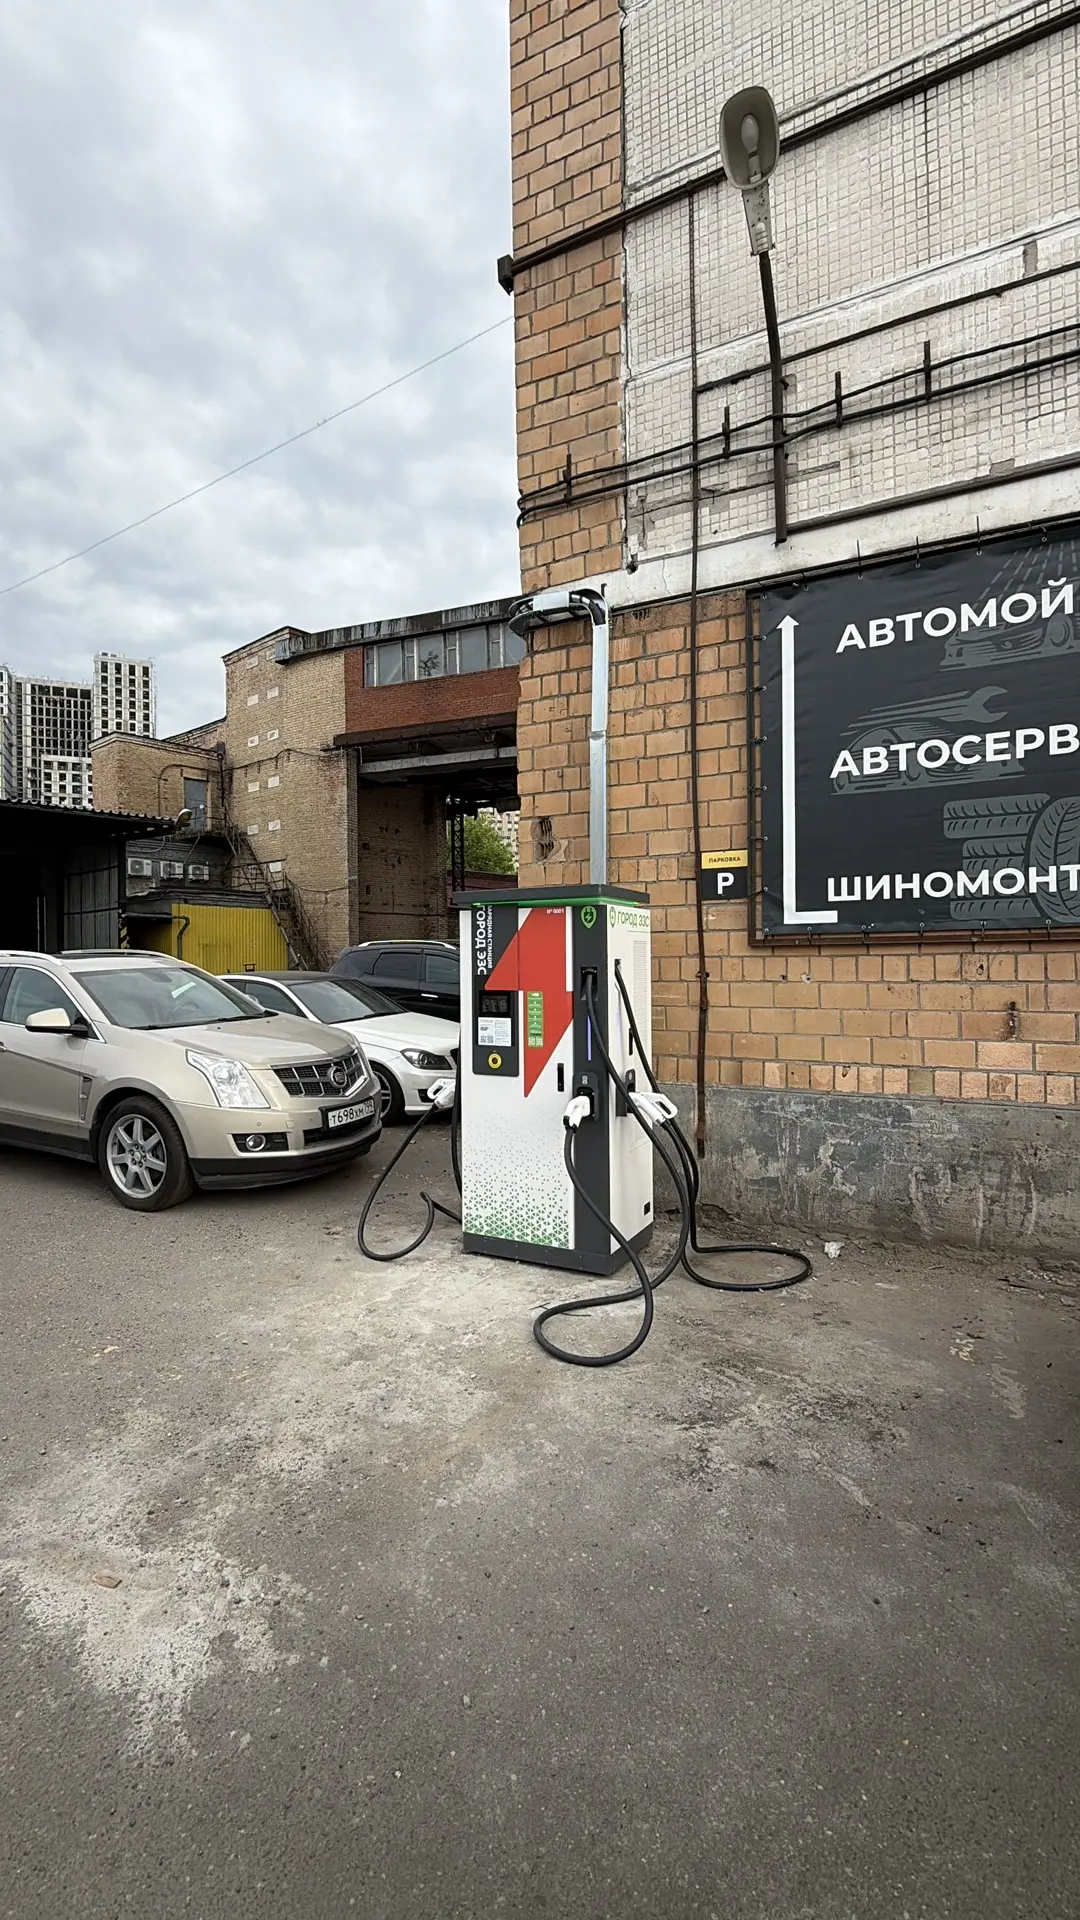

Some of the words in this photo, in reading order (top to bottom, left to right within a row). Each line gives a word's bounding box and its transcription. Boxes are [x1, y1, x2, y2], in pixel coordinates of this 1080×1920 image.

[835, 576, 1074, 654] АВТОМОЙ
[829, 723, 1080, 779] АВТОСЕРВ
[708, 856, 741, 864] ПАРКОВКА
[717, 872, 735, 895] P
[827, 864, 1080, 902] ШИНОМОНТ
[474, 904, 487, 949] ГОРОД
[616, 911, 638, 928] ГОРОД
[638, 914, 650, 928] ЭЗС
[476, 950, 487, 976] ЭЗС
